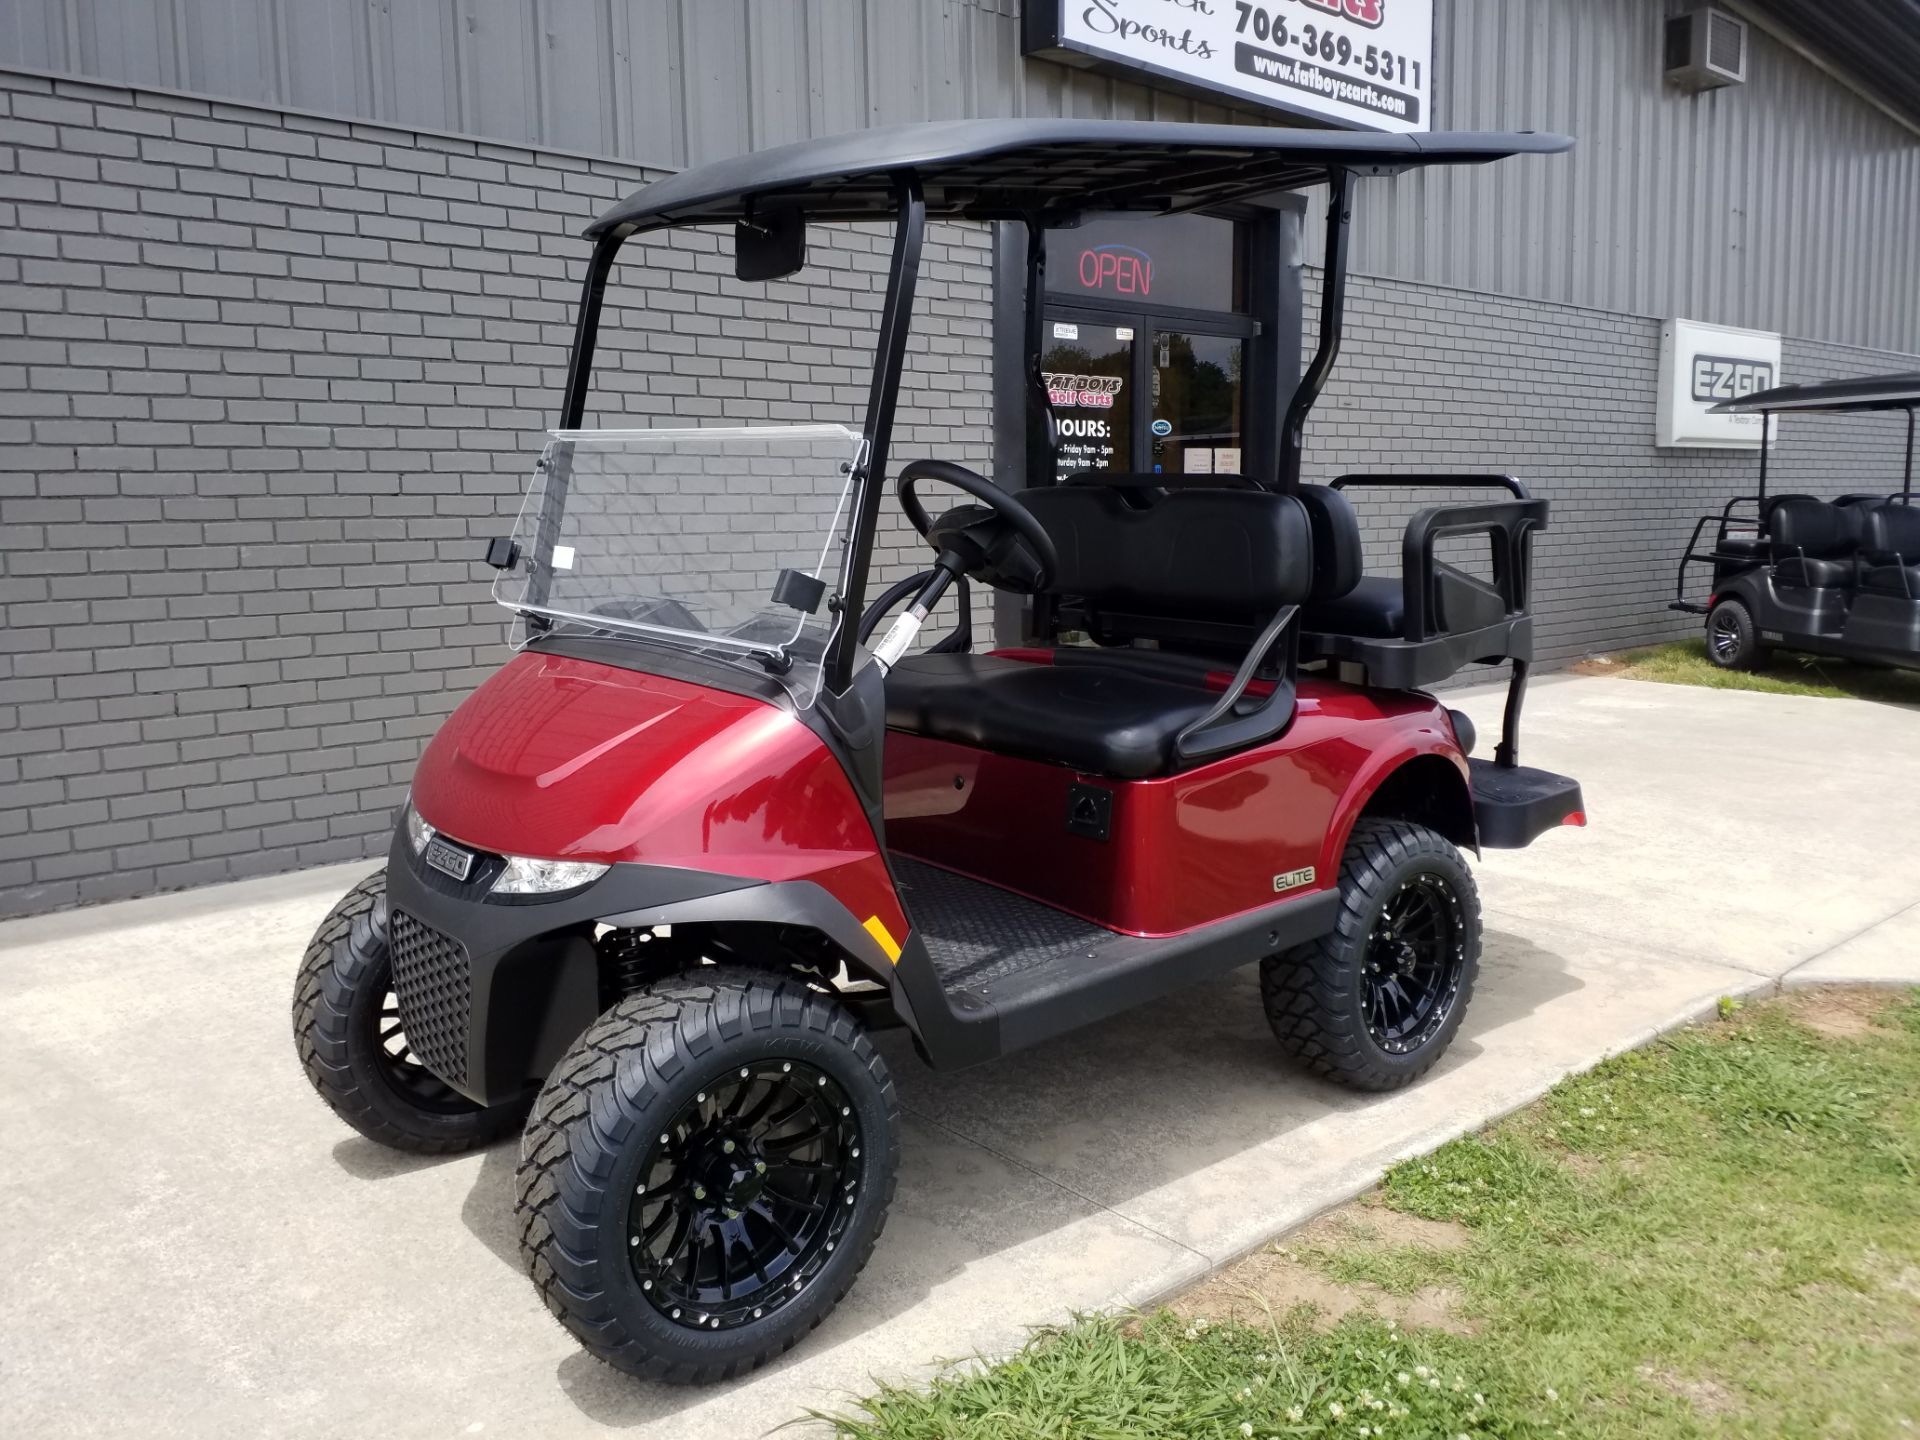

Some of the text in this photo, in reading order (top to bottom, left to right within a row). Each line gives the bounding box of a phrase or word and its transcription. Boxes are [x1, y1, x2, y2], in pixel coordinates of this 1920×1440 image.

[1082, 0, 1218, 59] Sports
[1235, 0, 1421, 90] 706-369-5311
[1253, 55, 1406, 115] www.fatboyscarts.com
[1079, 250, 1150, 295] OPEN
[1075, 375, 1122, 395] BOYS
[1050, 390, 1112, 407] Golf Carts
[1064, 443, 1082, 456] Friday
[1083, 444, 1096, 454] 9am
[1101, 444, 1114, 457] 5pm
[1078, 457, 1091, 467] 9am
[1096, 457, 1109, 470] 2pm
[429, 842, 468, 875] EZGO
[1276, 869, 1313, 889] ELITE
